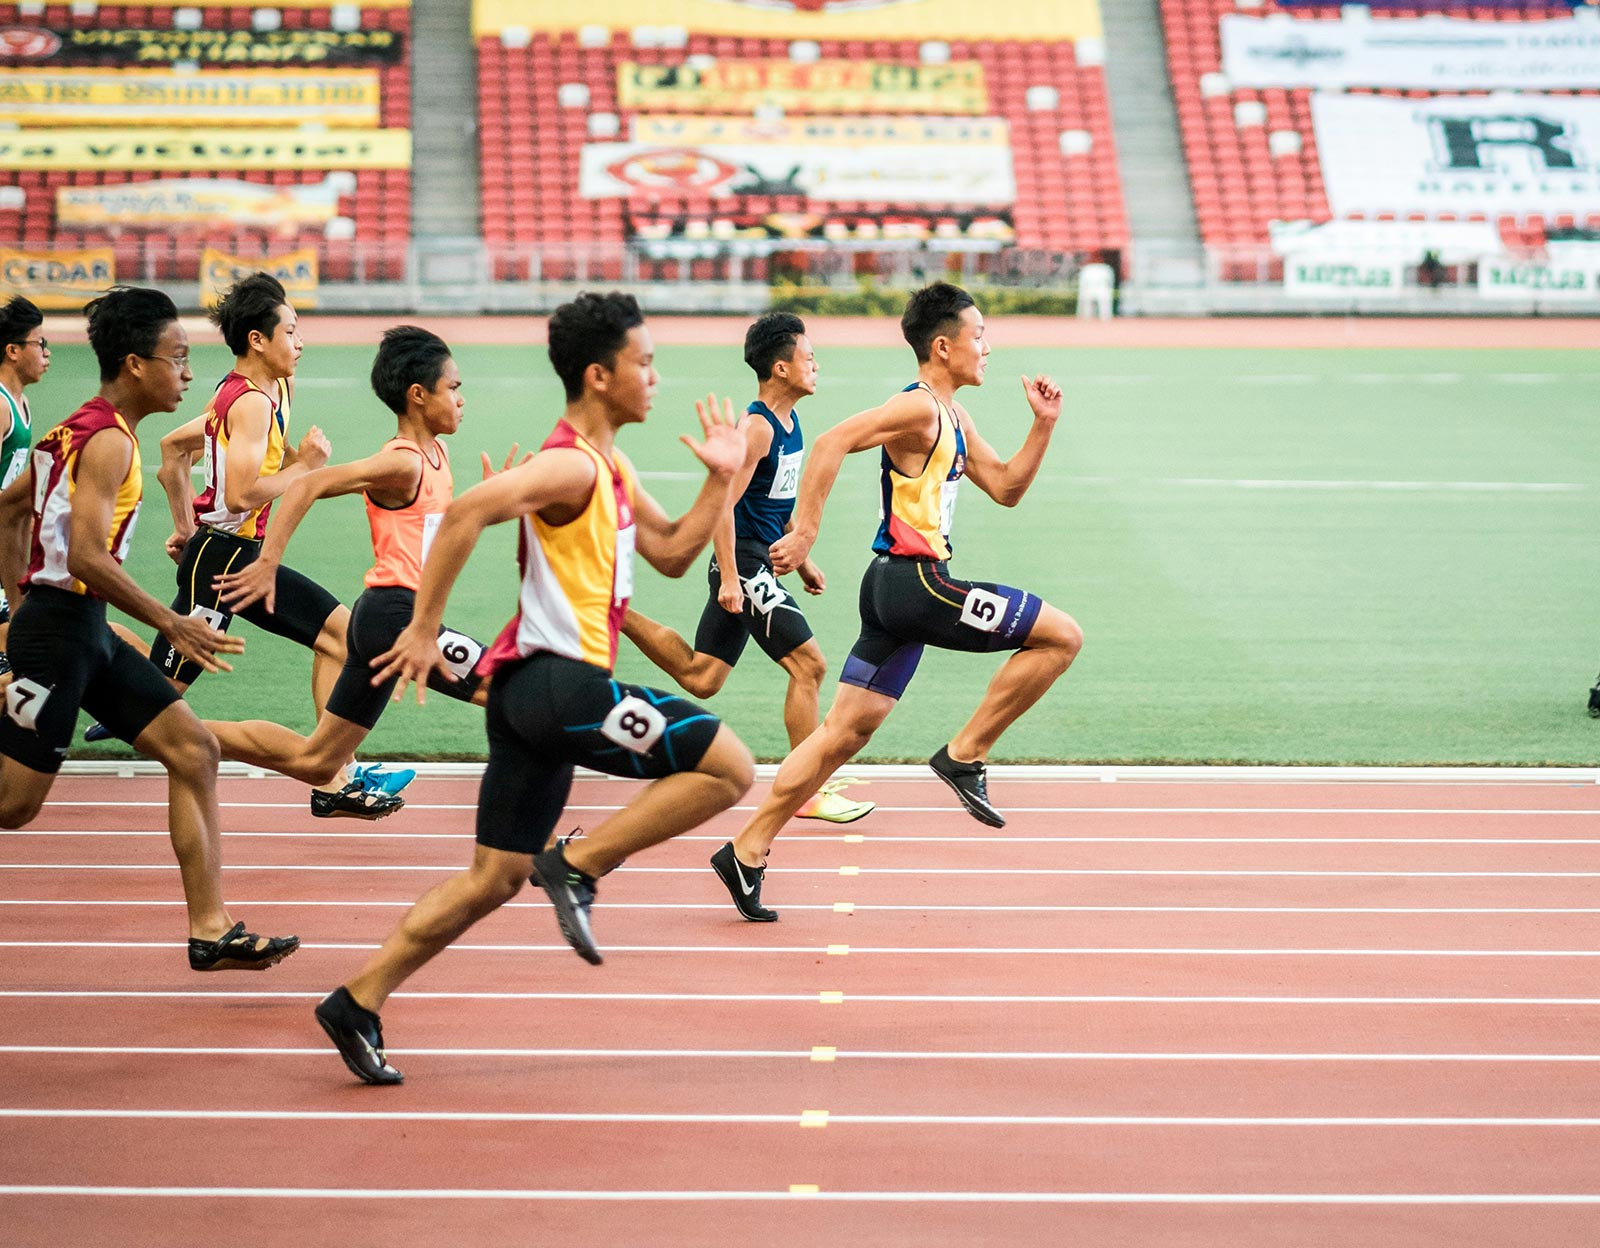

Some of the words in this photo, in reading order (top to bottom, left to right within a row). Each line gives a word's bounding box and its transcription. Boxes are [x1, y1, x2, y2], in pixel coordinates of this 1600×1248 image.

[1420, 114, 1584, 172] R
[1418, 181, 1600, 196] RAFFLE
[4, 258, 109, 281] CEDAR
[209, 260, 310, 281] CEAR
[754, 581, 776, 605] 2
[970, 597, 996, 622] 5
[442, 641, 469, 664] 6
[15, 685, 37, 715] 7
[619, 709, 649, 739] 8
